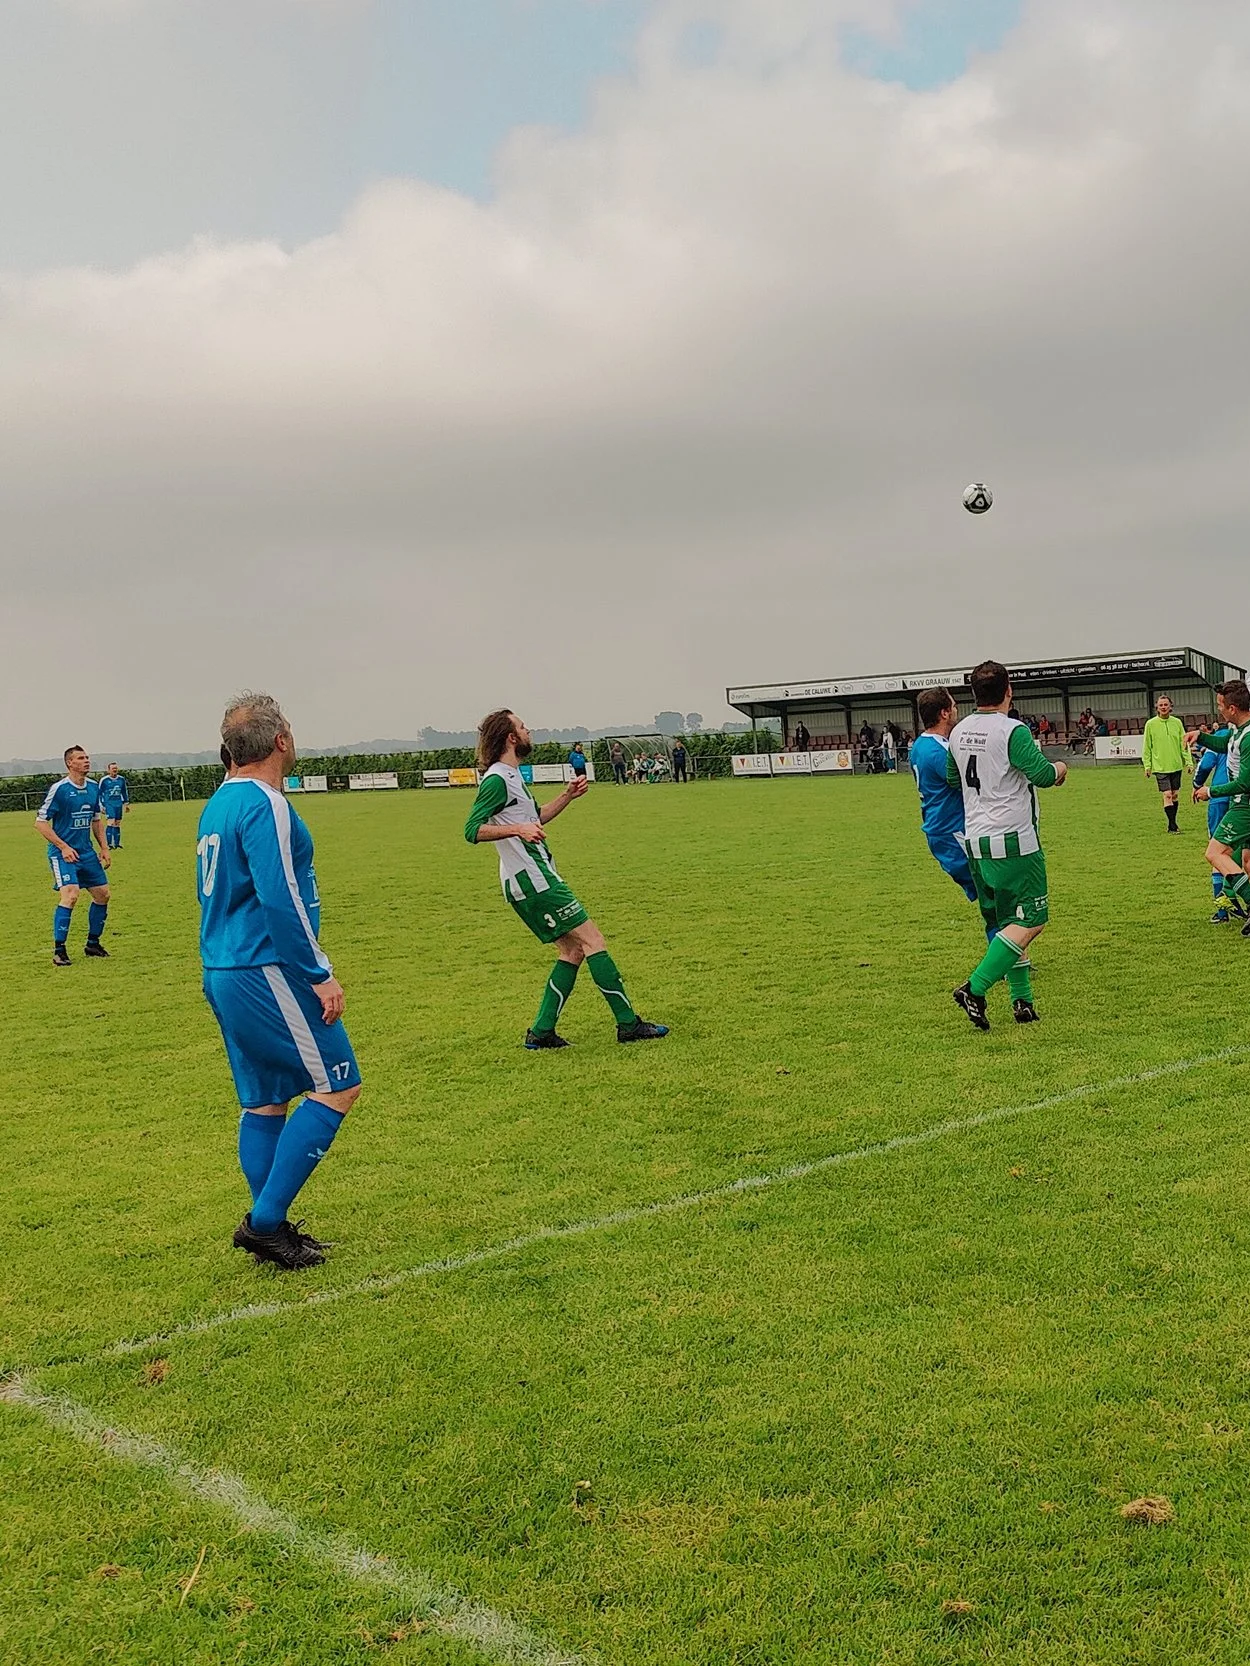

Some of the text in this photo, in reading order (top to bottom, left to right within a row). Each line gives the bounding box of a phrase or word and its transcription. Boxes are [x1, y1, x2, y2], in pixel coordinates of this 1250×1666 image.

[925, 678, 951, 686] GRAAUW
[965, 754, 981, 795] 4
[197, 833, 220, 896] 17
[544, 913, 556, 928] 3
[332, 1061, 350, 1080] 17
